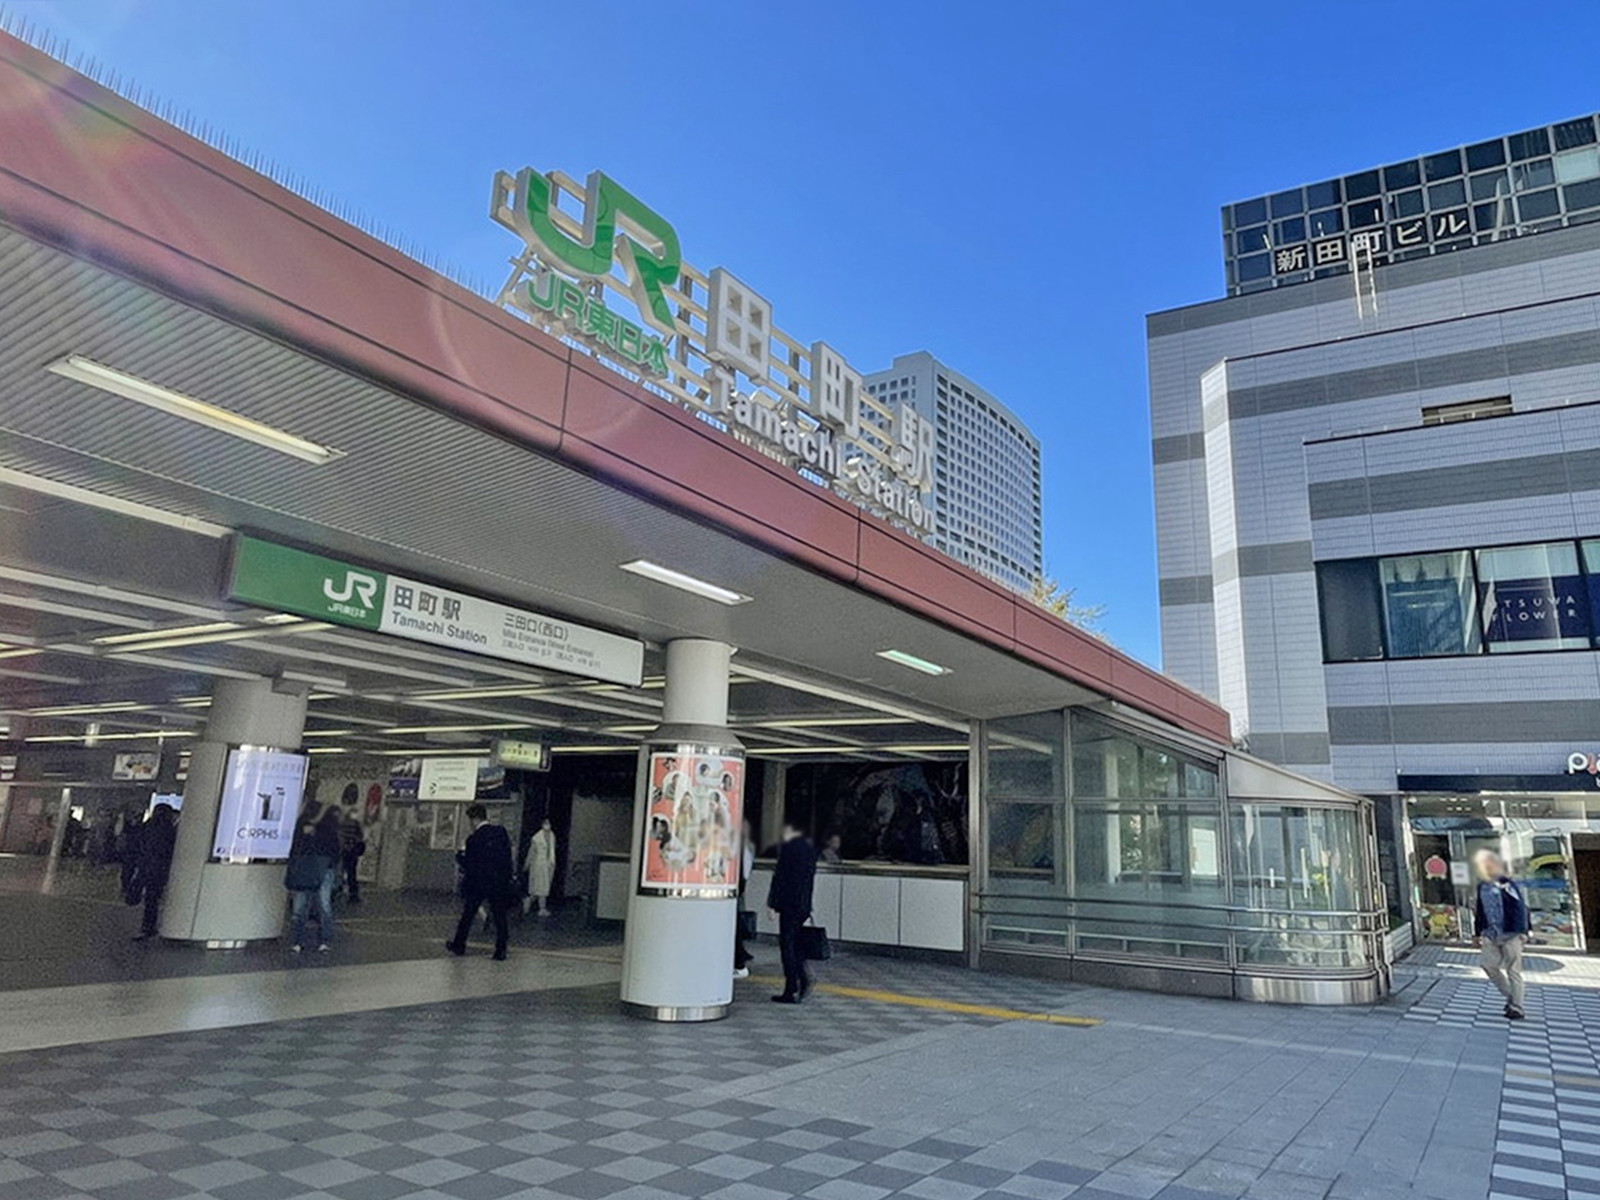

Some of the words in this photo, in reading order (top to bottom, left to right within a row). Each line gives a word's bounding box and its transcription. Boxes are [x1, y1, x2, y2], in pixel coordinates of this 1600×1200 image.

[517, 166, 681, 332] JR
[1276, 214, 1467, 272] 新田町ビル
[526, 270, 667, 374] JR東日本
[708, 267, 933, 490] 田町駅
[706, 367, 849, 478] Tamachi
[857, 460, 934, 531] Station
[323, 571, 378, 609] JR
[392, 611, 444, 635] Tamachi
[447, 624, 488, 645] Station
[393, 584, 461, 622] 田町駅
